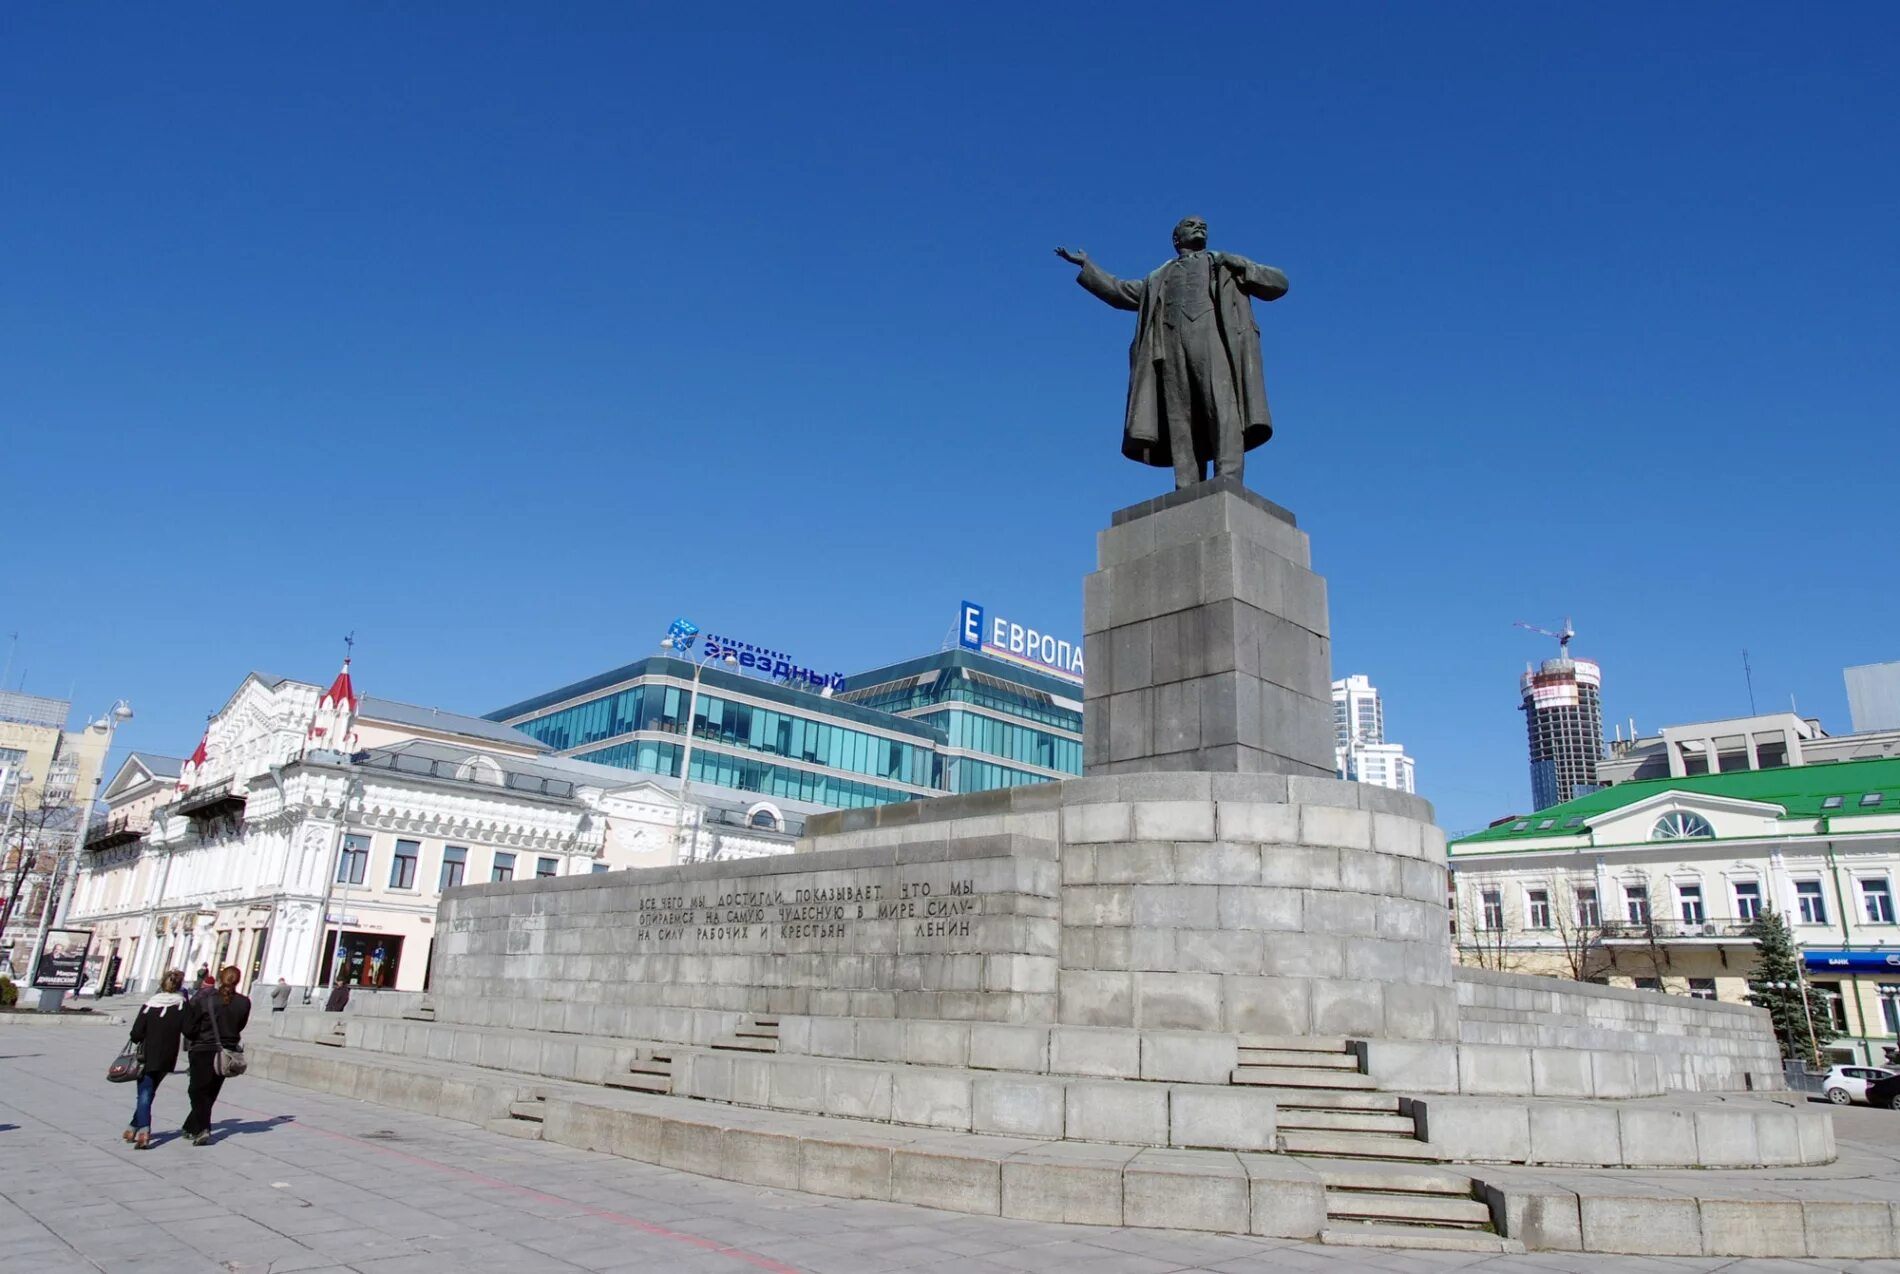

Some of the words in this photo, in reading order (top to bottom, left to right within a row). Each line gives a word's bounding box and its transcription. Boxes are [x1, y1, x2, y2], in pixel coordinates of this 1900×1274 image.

[707, 633, 792, 662] СУПЕРМАРКЕТ
[993, 616, 1084, 674] ЕВРОПА
[639, 898, 656, 911] ВСЕ
[661, 896, 684, 910] ЧЕГО
[690, 895, 706, 909] МЫ
[901, 881, 931, 900] ЧТО
[949, 879, 974, 896] МЫ
[639, 912, 695, 926] ОПИРАЕМСЯ
[705, 911, 720, 926] НА
[726, 909, 765, 924] САМУЮ
[778, 906, 845, 922] ЧУДЕСНУЮ
[857, 904, 864, 919] В
[878, 901, 915, 919] МИРЕ
[638, 929, 651, 942] НА
[658, 928, 685, 941] СИЛУ
[696, 926, 749, 941] РАБОЧИХ
[760, 926, 768, 940] И
[780, 924, 846, 940] КРЕСТЬЯН
[915, 920, 971, 938] ЛЕНИН
